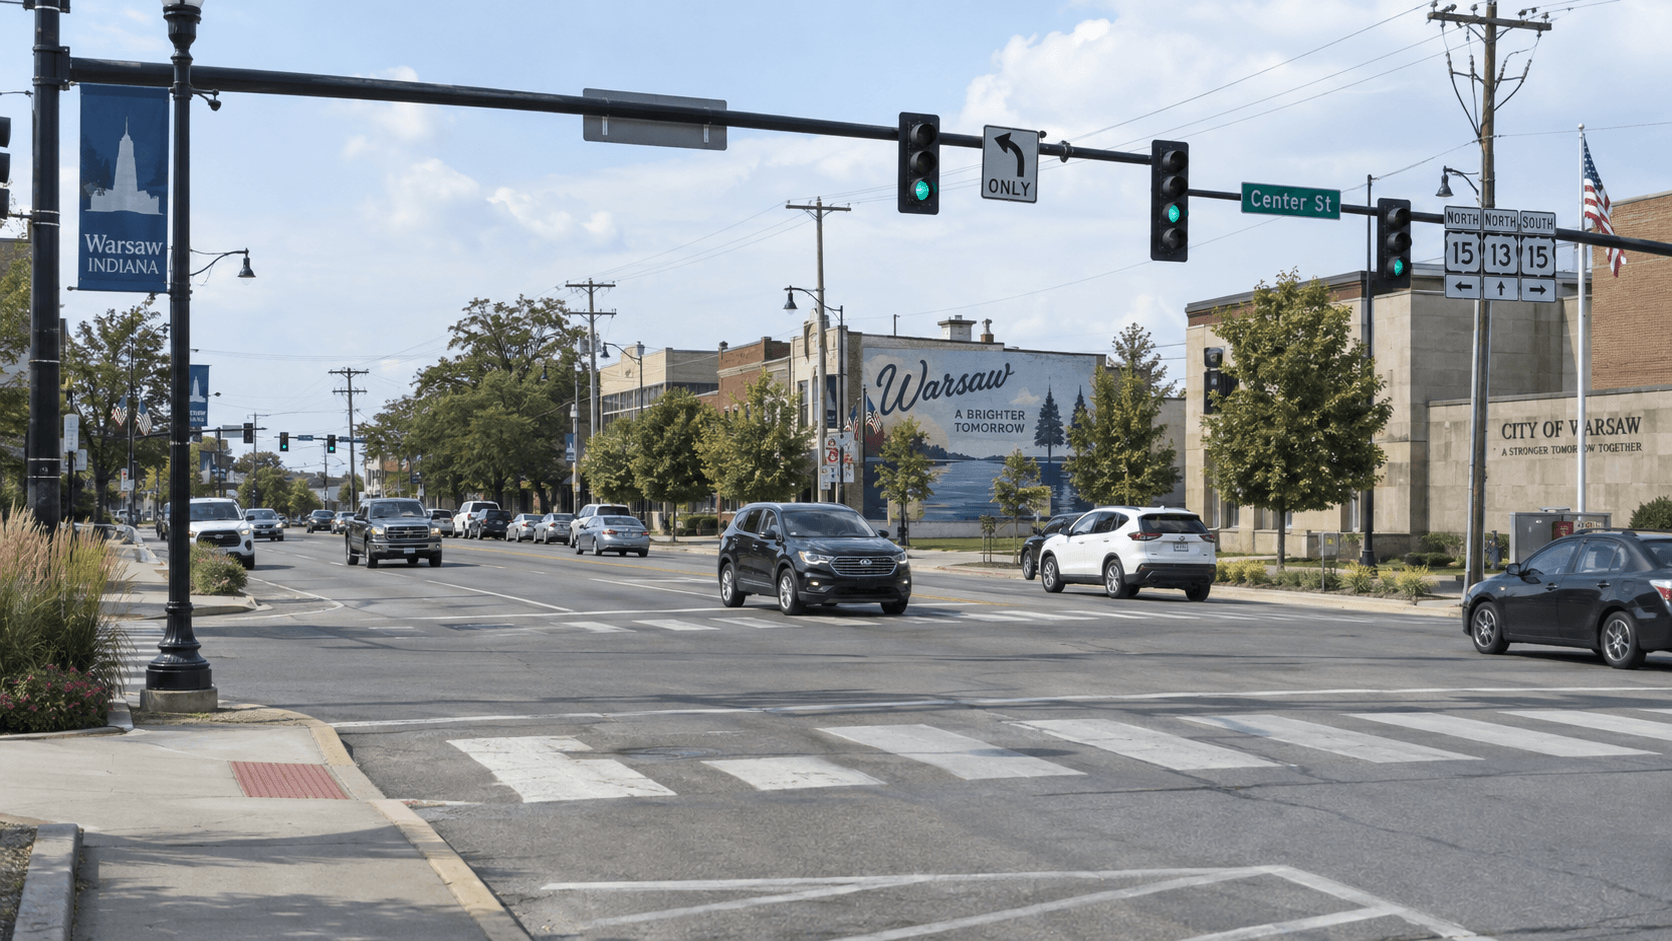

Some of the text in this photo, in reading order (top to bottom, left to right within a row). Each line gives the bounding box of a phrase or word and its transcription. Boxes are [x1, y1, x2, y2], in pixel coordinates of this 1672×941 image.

[988, 178, 1031, 197] ONLY
[1251, 189, 1332, 212] Center St
[1447, 210, 1479, 225] NORTH
[1485, 213, 1516, 228] NORTH
[1522, 215, 1553, 230] SOUTH
[84, 233, 163, 256] Warsaw
[1452, 241, 1474, 265] 15
[1490, 243, 1511, 267] 13
[1528, 245, 1548, 269] 15
[87, 257, 160, 275] INDIANA
[876, 359, 1016, 416] Warsaw
[954, 409, 1026, 421] A BRIGHTER
[954, 422, 1026, 434] TOMORROW
[1501, 416, 1642, 440] CITY OF WARSAW
[1501, 441, 1643, 457] A STRONGER TOMOROW TOGETHER
